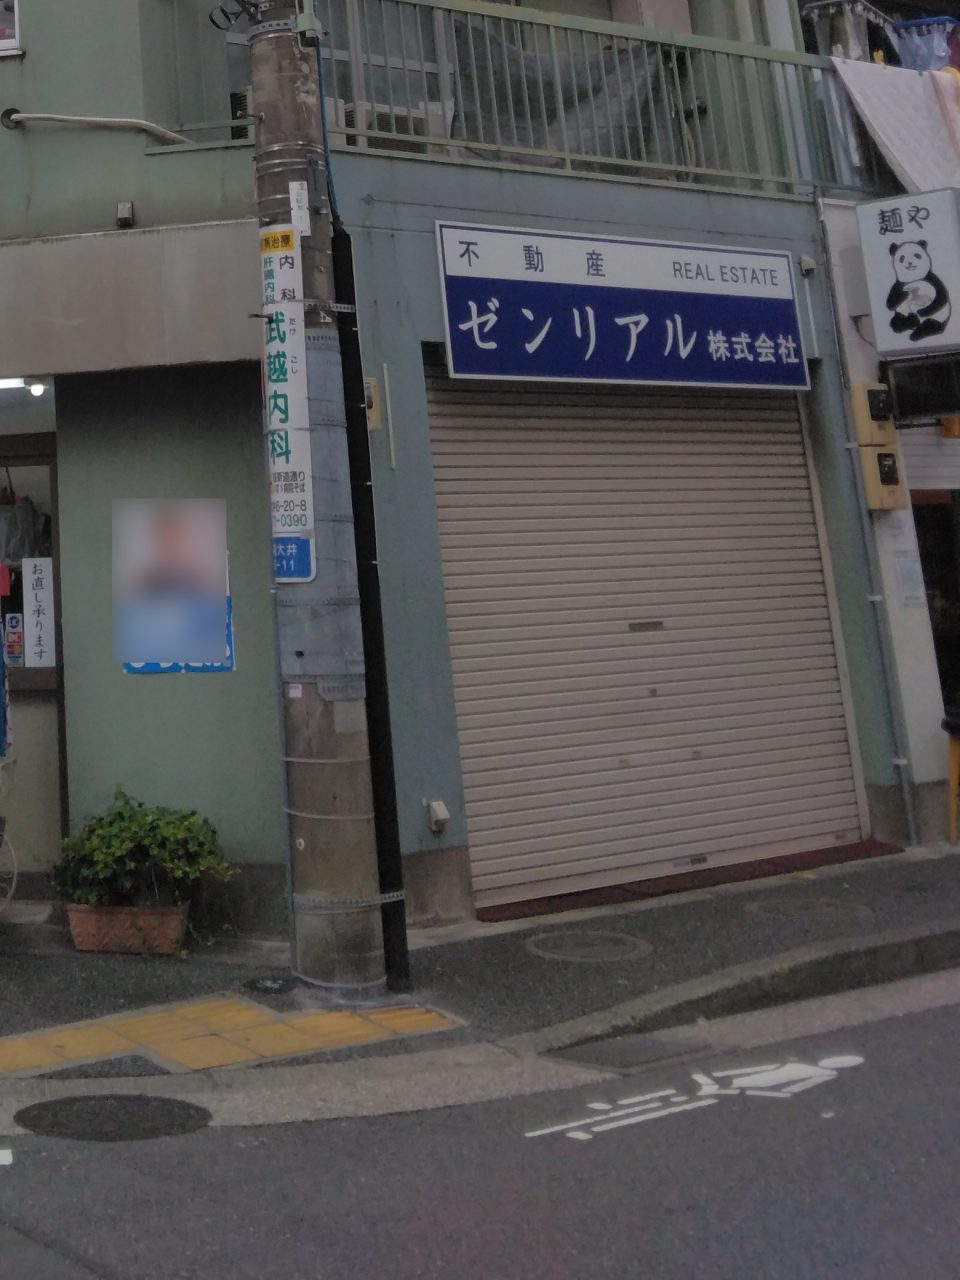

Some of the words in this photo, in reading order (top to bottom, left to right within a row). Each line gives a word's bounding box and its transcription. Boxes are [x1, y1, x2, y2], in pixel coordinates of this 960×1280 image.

[458, 240, 607, 278] 不動産
[672, 260, 715, 282] REAL
[719, 264, 779, 286] ESTATE
[279, 255, 296, 300] 内科
[265, 310, 291, 465] 武越内科
[272, 513, 308, 527] -0390
[273, 543, 298, 557] 大井
[273, 559, 295, 571] -11
[31, 563, 47, 661] お直し承ります
